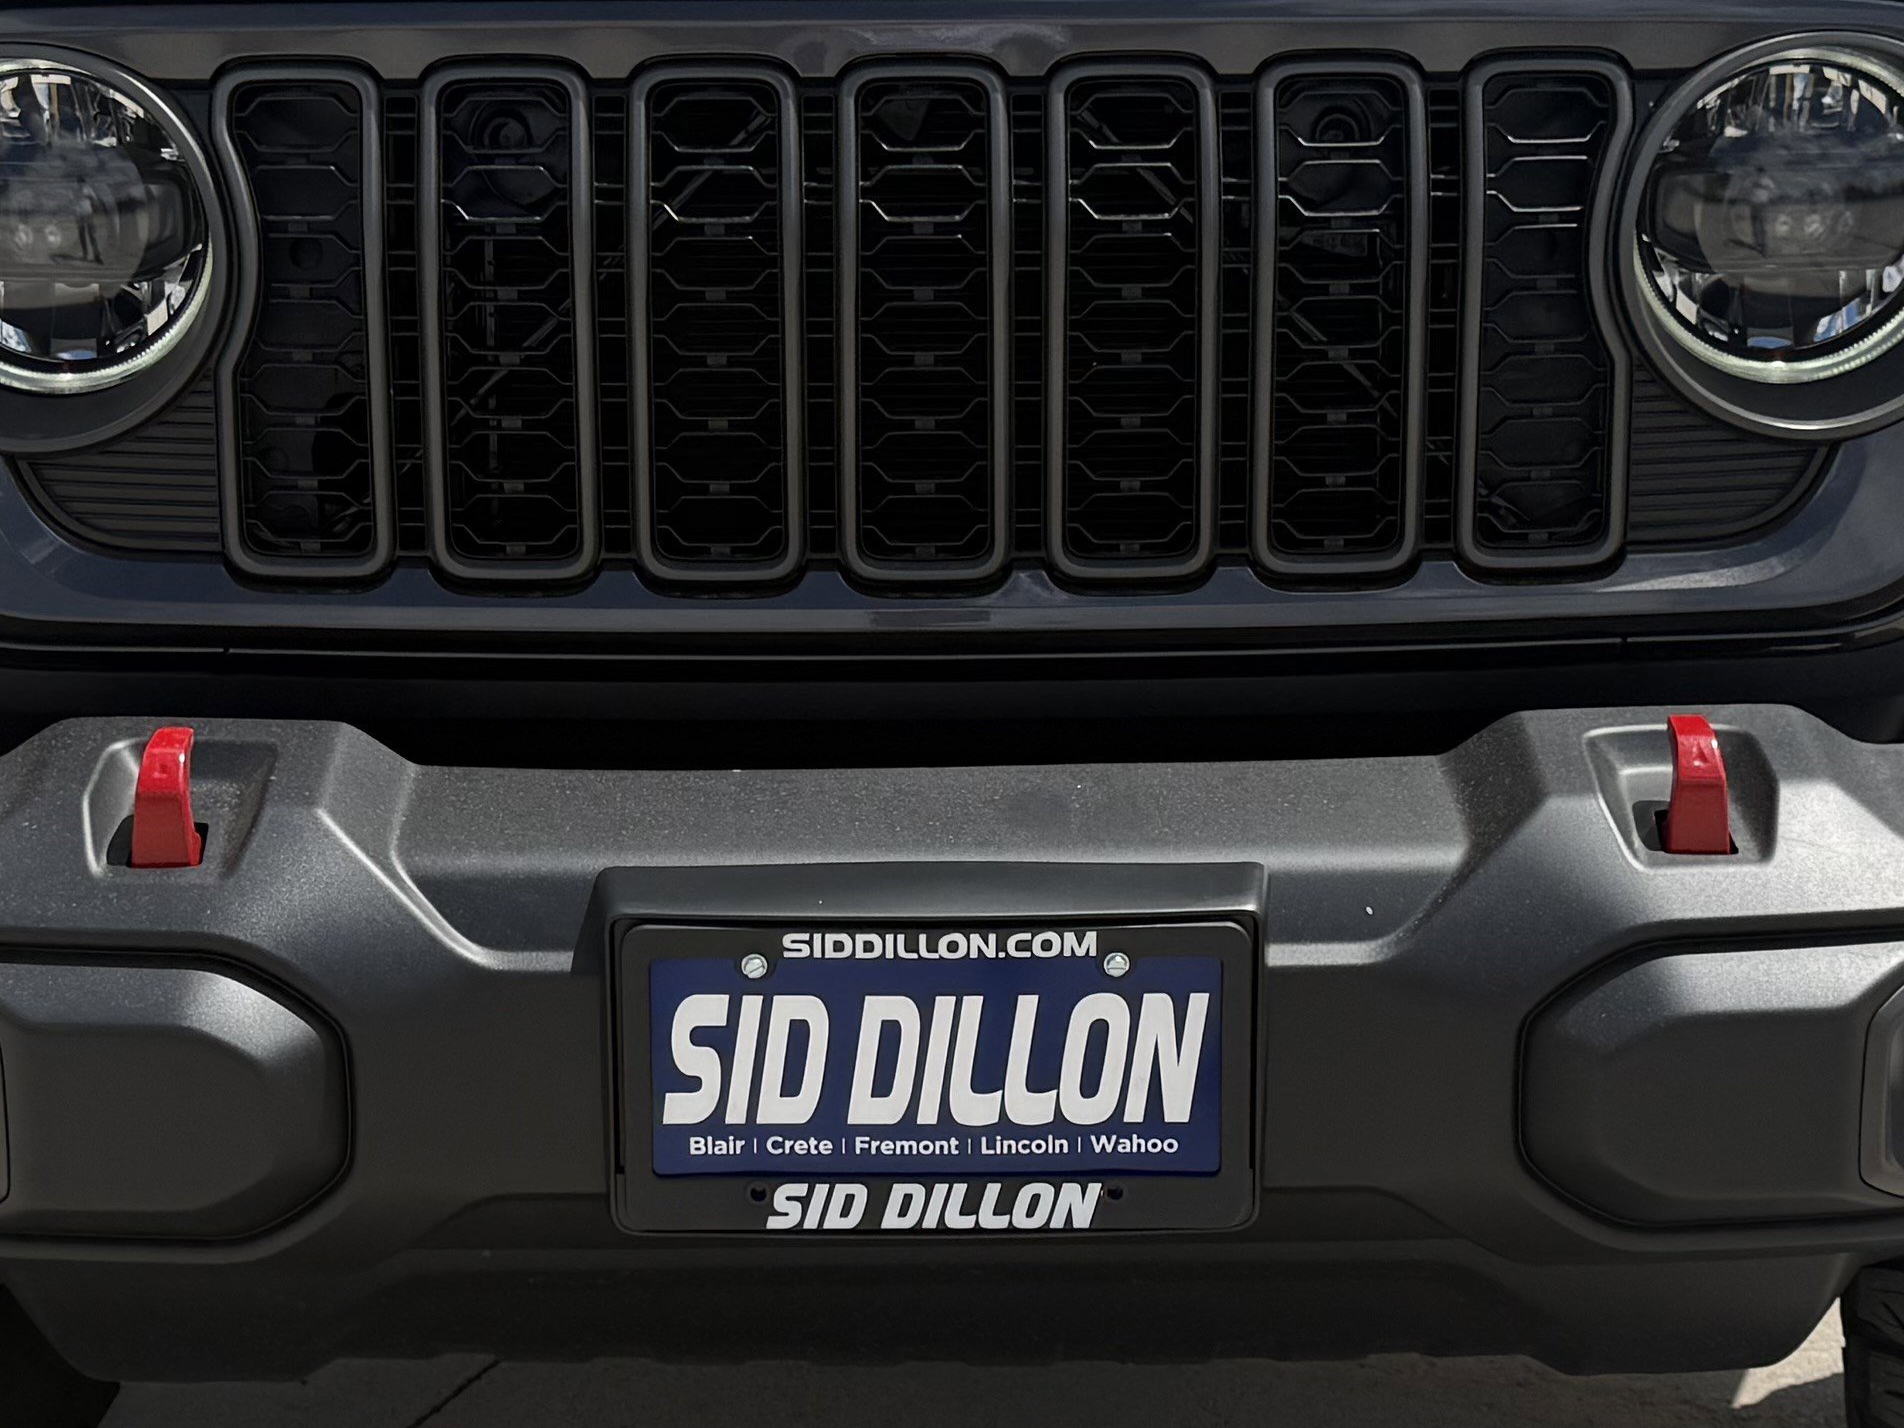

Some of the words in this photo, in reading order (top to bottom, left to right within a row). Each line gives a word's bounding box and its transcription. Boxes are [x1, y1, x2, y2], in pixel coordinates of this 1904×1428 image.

[782, 930, 1097, 960] SIDDILLON.COM
[662, 993, 830, 1125] SID
[846, 992, 1210, 1127] DILLON
[689, 1135, 746, 1155] Blair
[766, 1135, 834, 1155] Crete
[855, 1136, 960, 1155] Fremont
[981, 1134, 1069, 1155] Lincoln
[1090, 1133, 1179, 1154] Wahoo
[765, 1182, 868, 1230] SID
[880, 1182, 1100, 1230] DILLON
